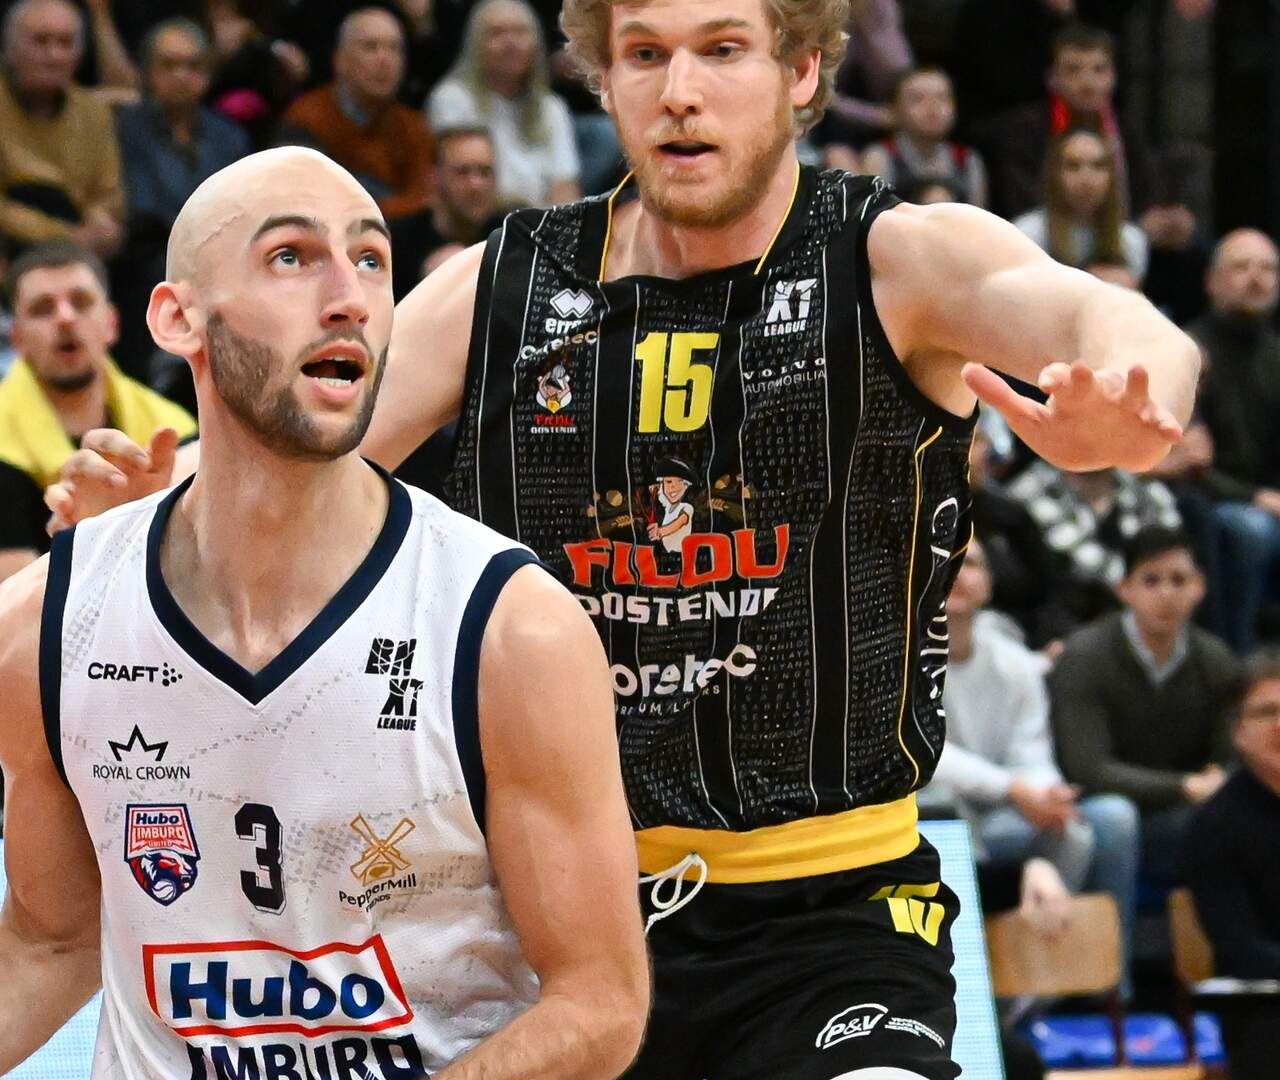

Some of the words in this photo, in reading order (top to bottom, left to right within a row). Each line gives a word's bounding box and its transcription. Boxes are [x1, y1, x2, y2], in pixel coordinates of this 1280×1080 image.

[764, 319, 807, 337] LEAGUE
[635, 332, 721, 433] 15
[563, 523, 790, 589] FILOU
[87, 662, 159, 683] CRAFT
[376, 717, 417, 731] LEAGUE
[92, 764, 132, 780] ROYAL
[135, 765, 191, 780] CROWN
[135, 812, 180, 825] Hubo
[234, 803, 285, 915] 3
[170, 959, 385, 1021] Hubo
[823, 1012, 885, 1044] P&V
